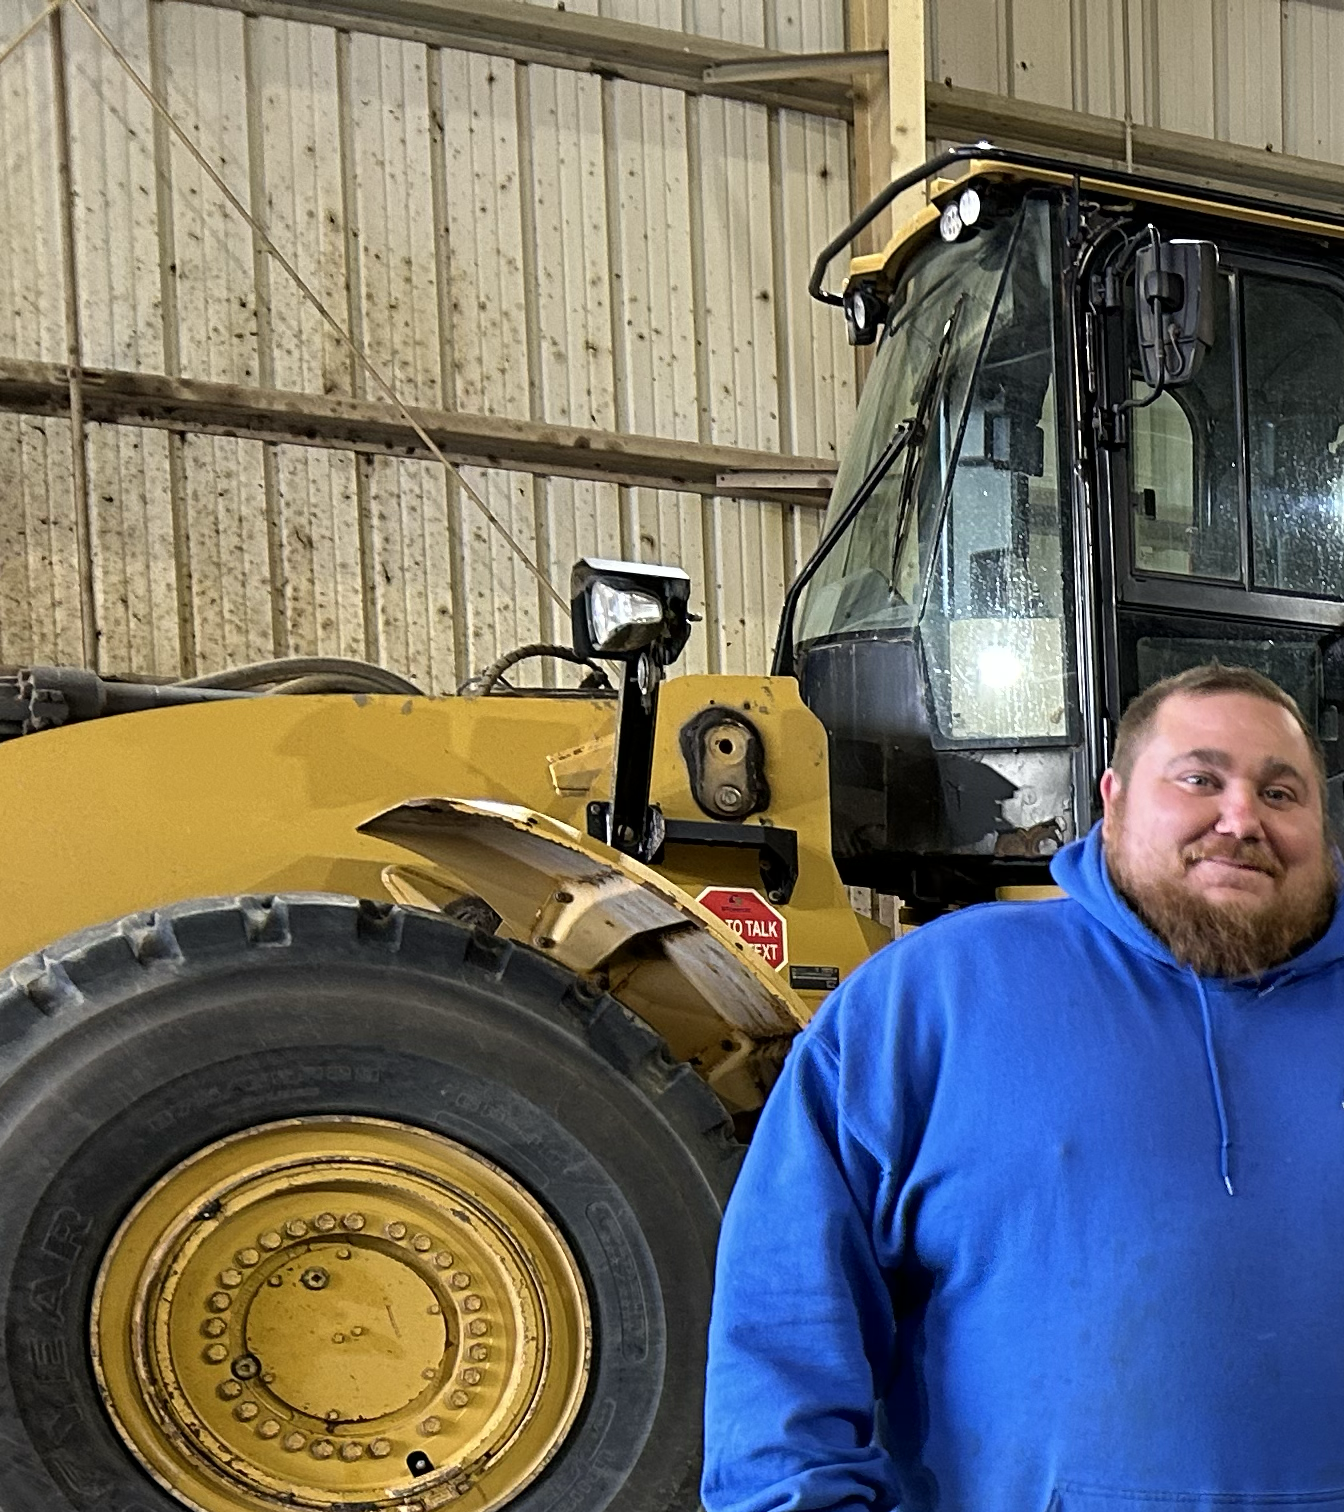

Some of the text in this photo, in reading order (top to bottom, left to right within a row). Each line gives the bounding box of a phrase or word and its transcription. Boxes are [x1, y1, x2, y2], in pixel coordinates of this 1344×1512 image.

[725, 919, 778, 937] TO TALK
[750, 944, 778, 961] EXT
